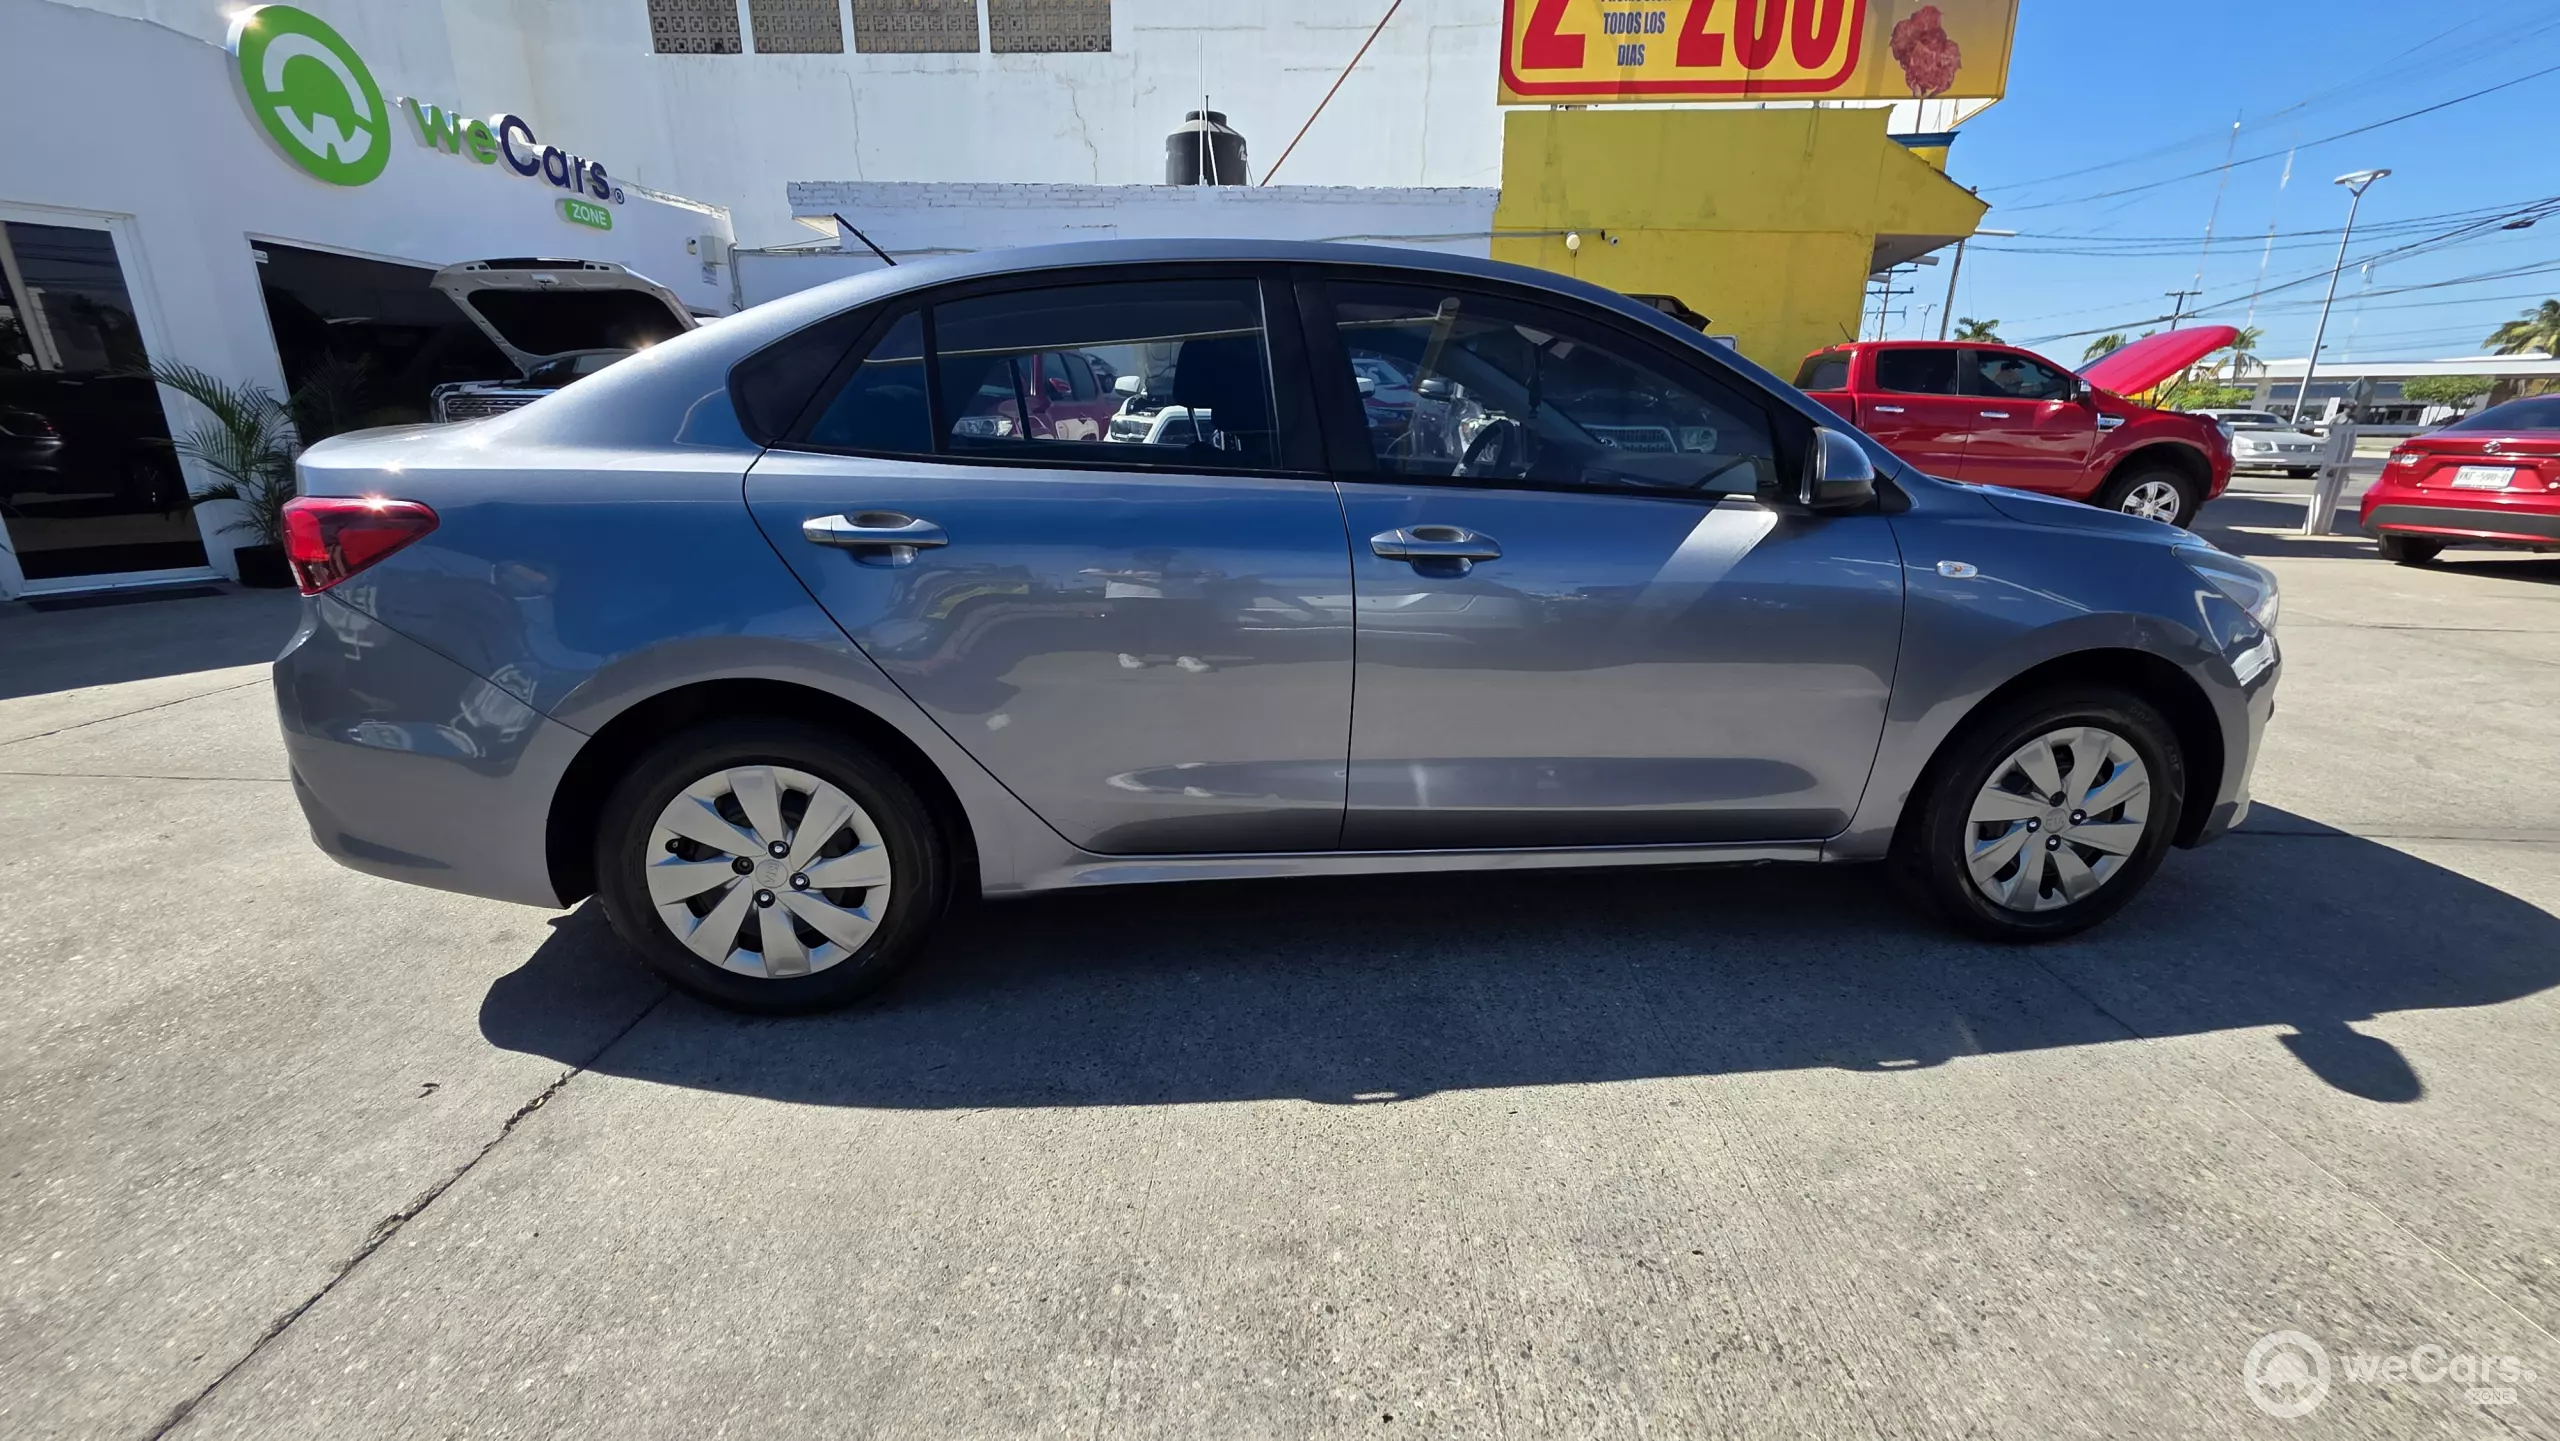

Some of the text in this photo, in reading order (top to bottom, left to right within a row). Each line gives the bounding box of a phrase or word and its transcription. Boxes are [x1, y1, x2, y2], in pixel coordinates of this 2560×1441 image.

[1603, 11, 1666, 34] TODOS LOS
[1617, 44, 1646, 66] DIAS
[571, 202, 608, 226] ZONE
